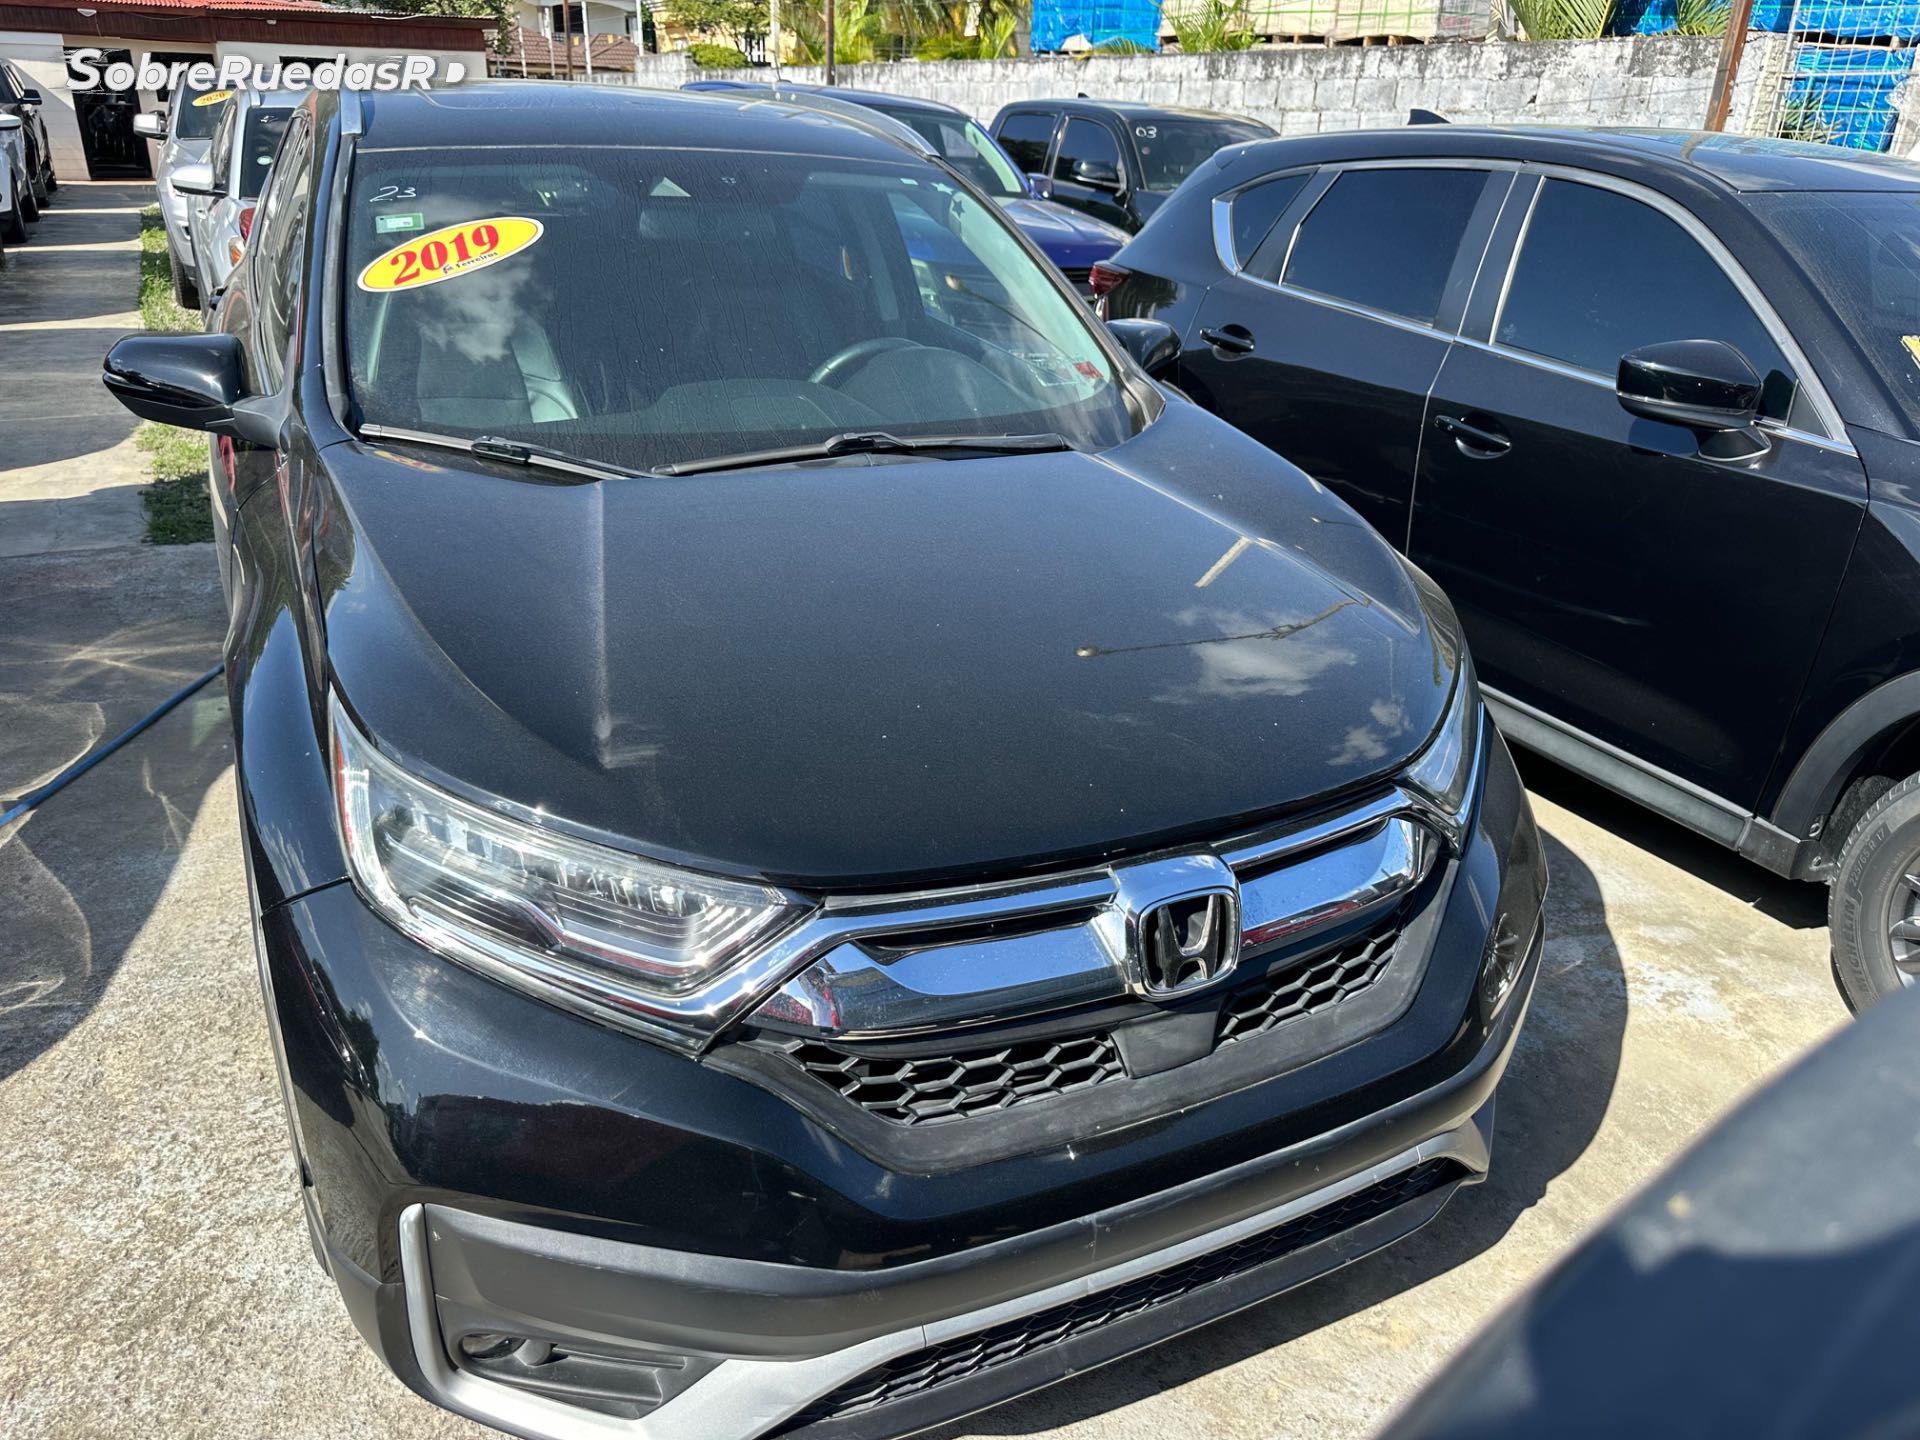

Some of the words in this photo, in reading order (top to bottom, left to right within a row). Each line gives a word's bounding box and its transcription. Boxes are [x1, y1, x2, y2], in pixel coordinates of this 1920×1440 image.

[1135, 125, 1157, 139] 03
[369, 185, 417, 202] 23
[390, 224, 500, 286] 2019
